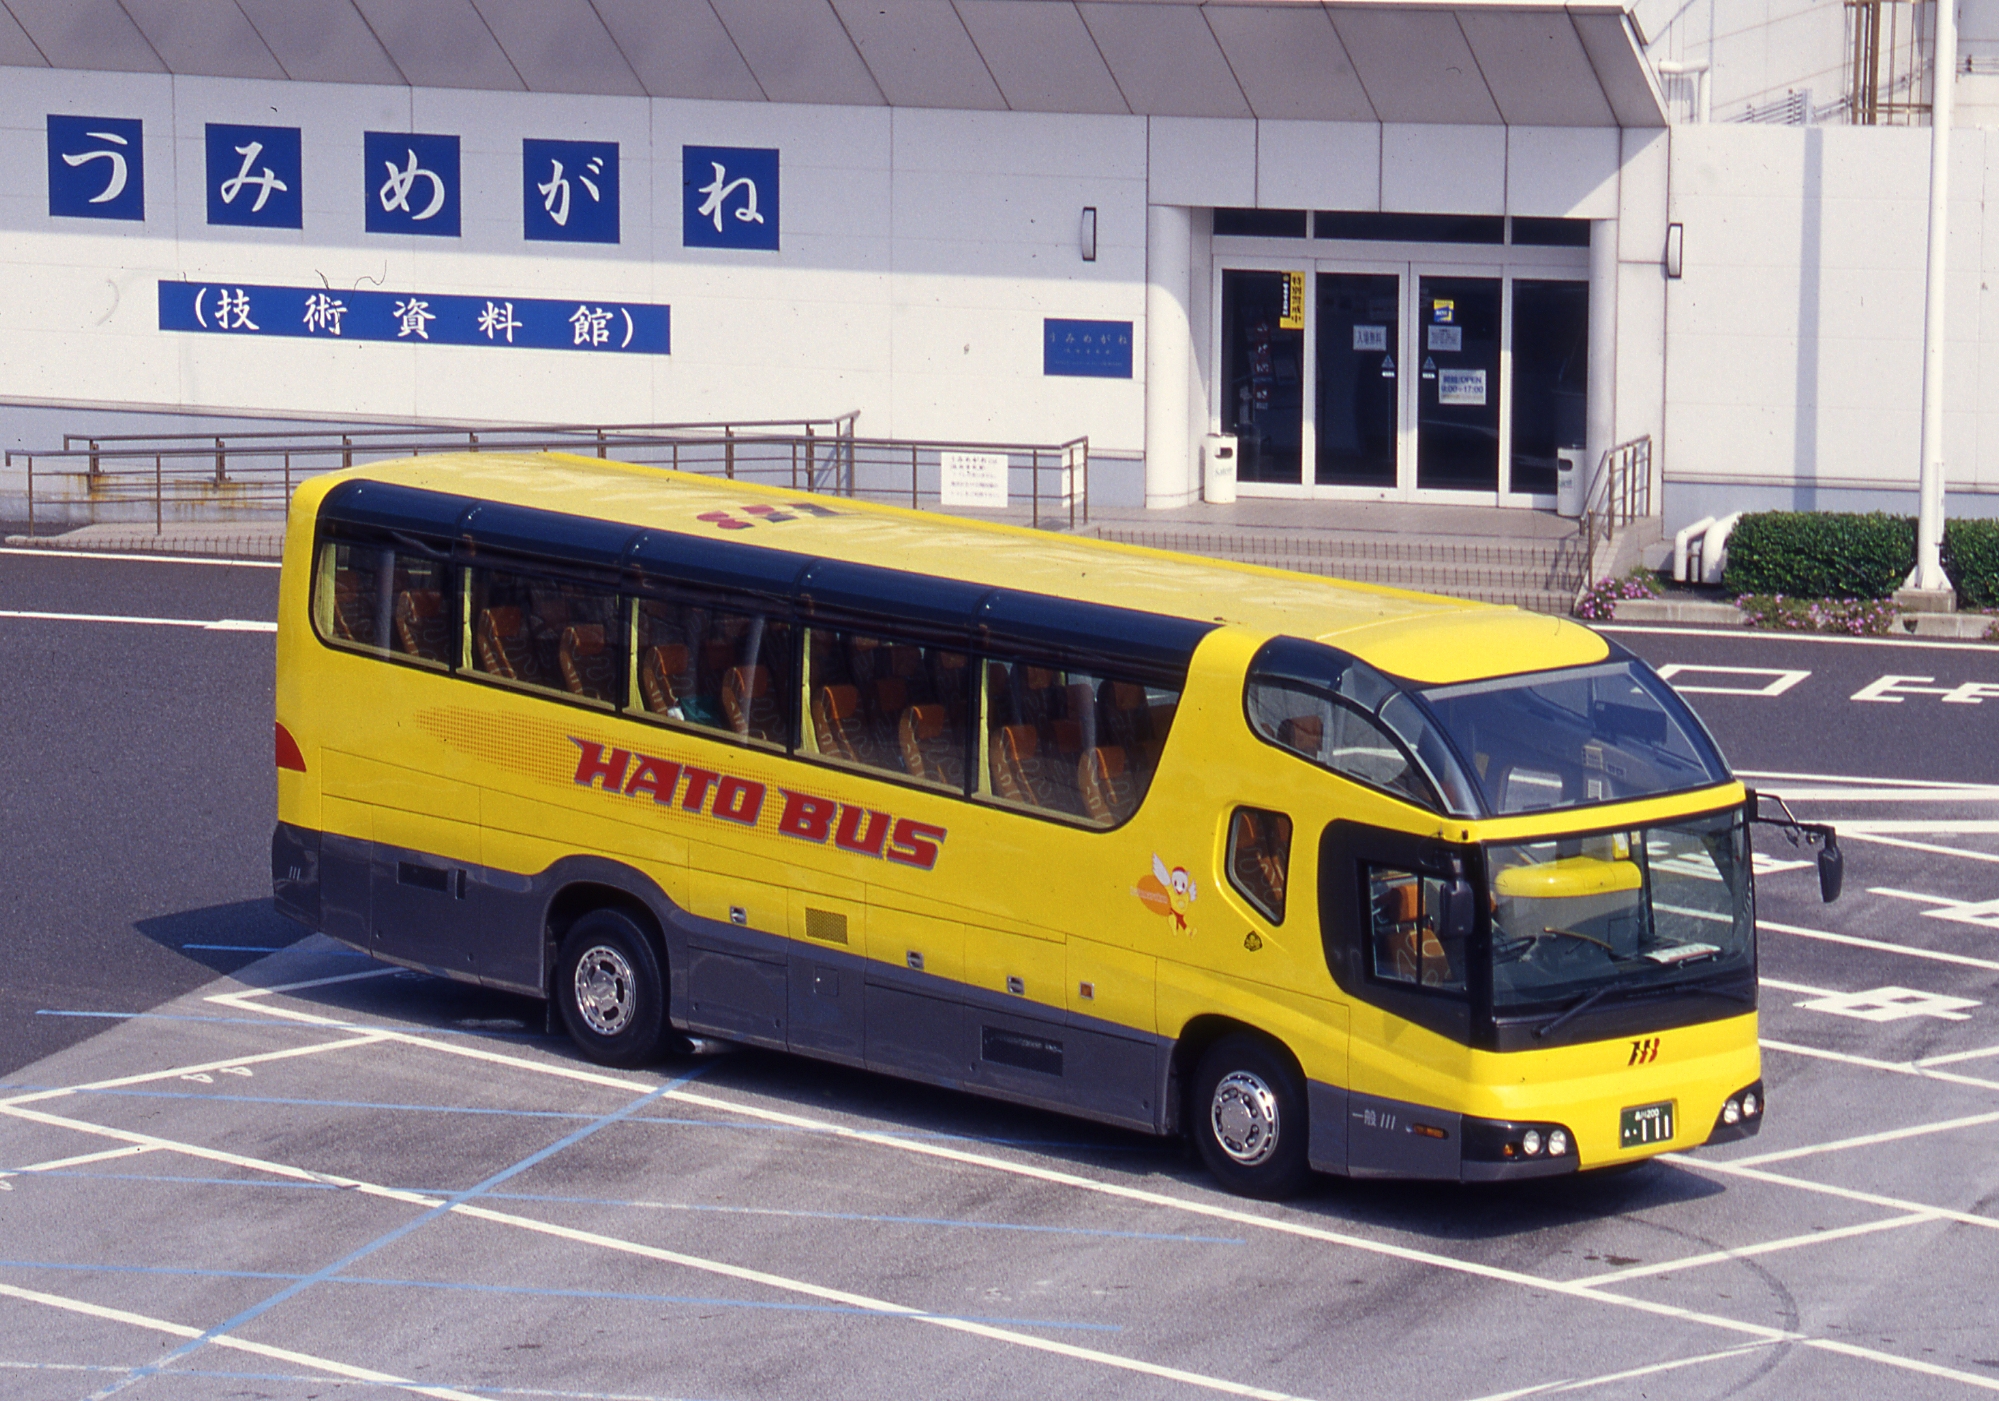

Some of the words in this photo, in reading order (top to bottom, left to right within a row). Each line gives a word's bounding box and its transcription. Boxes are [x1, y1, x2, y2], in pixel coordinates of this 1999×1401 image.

[62, 131, 764, 233] うみめがね
[567, 735, 767, 828] HATO
[777, 786, 948, 872] BUS
